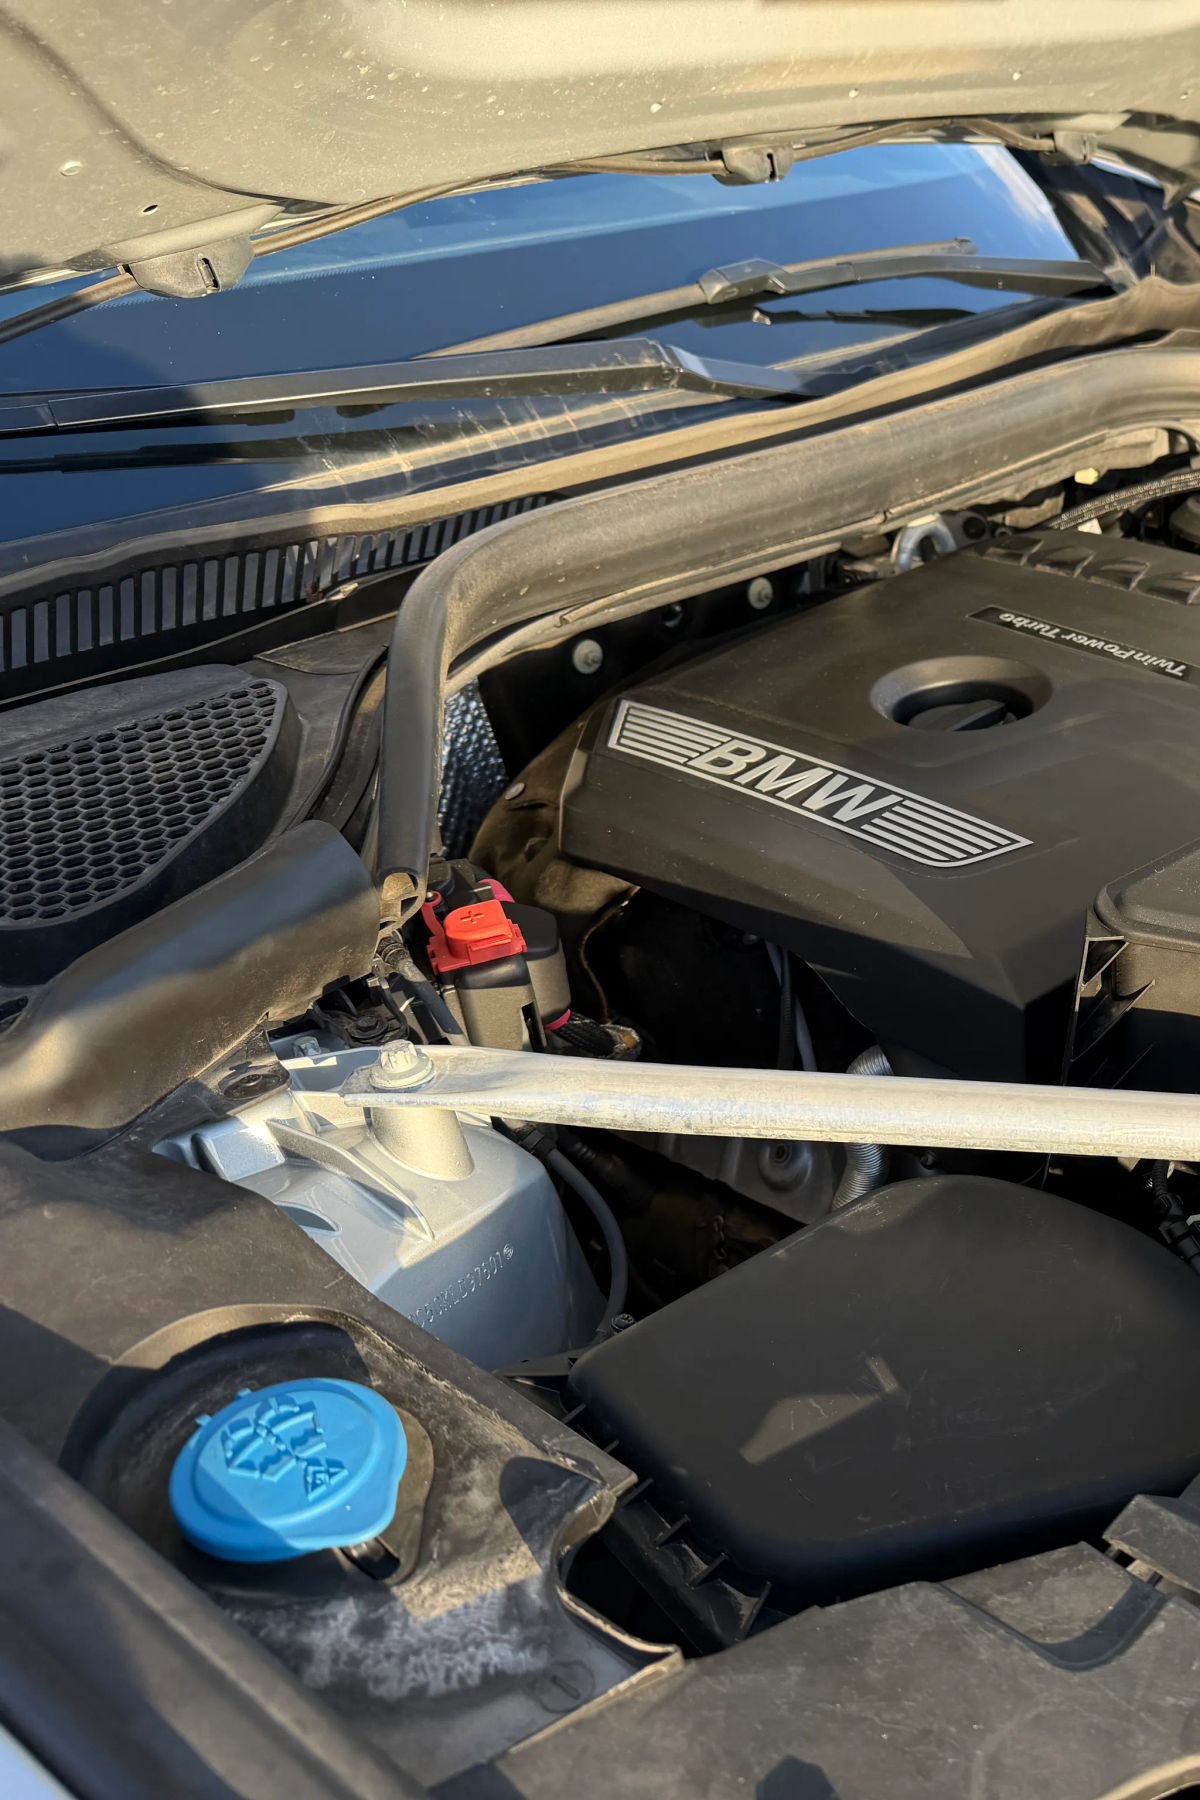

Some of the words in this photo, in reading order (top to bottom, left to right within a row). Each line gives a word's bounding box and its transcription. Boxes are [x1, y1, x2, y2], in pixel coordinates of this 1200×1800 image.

[998, 612, 1061, 639] Turbo
[1061, 630, 1186, 676] TwinPower
[687, 738, 904, 823] BMW
